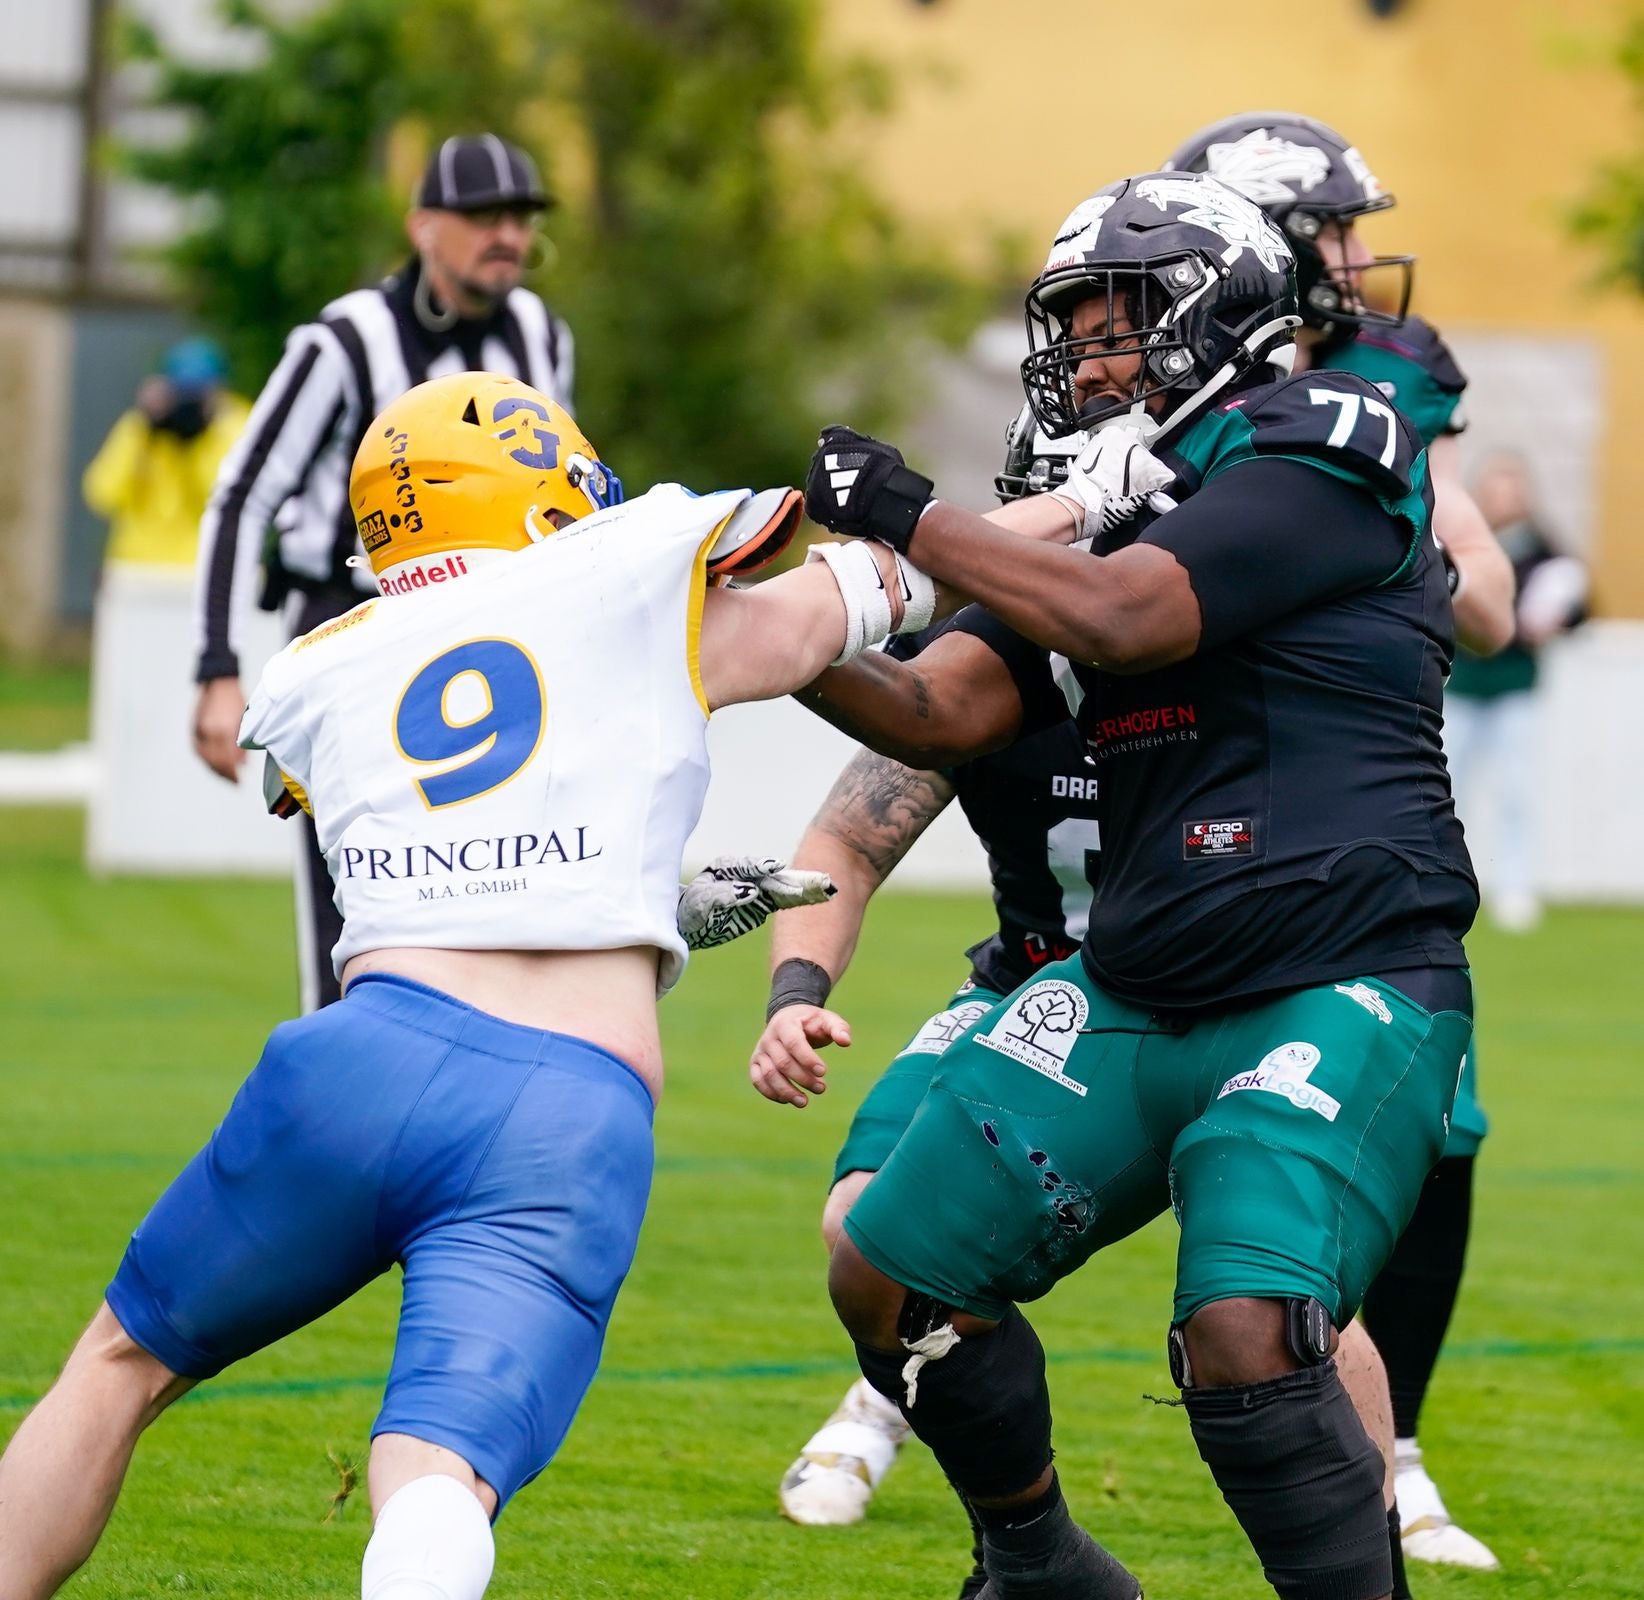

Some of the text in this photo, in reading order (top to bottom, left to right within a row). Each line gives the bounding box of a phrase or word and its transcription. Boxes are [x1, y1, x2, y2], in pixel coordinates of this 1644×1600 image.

[1309, 388, 1396, 470] 77
[392, 636, 547, 812] 9
[1052, 775, 1098, 800] DRA
[343, 825, 603, 880] PRINCIPAL
[417, 878, 528, 901] M.A. GMBH
[976, 1035, 1083, 1092] www.garten-miksch.com
